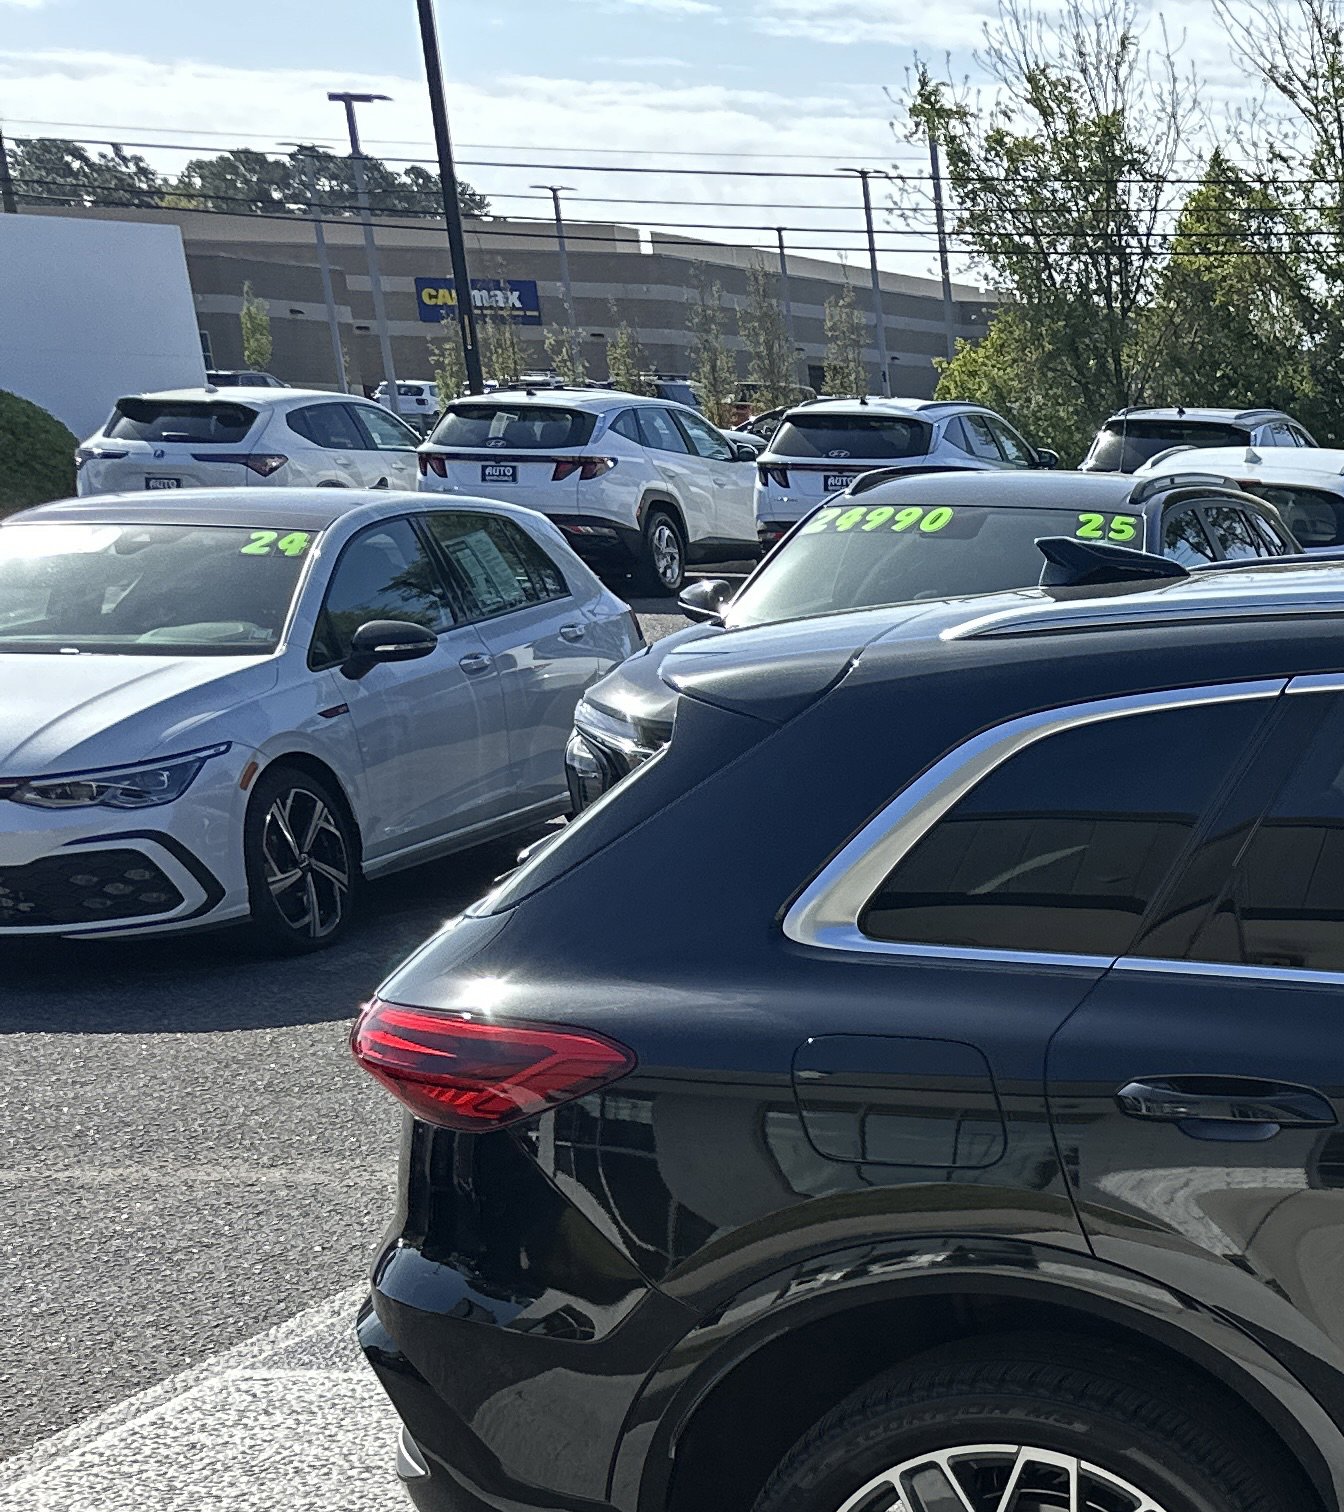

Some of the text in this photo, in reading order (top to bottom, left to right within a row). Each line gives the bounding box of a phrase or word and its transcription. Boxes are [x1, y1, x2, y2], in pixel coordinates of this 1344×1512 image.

[422, 288, 522, 308] CAmax
[486, 466, 513, 476] AUTO
[801, 506, 1137, 541] 24990 25
[240, 530, 311, 557] 24
